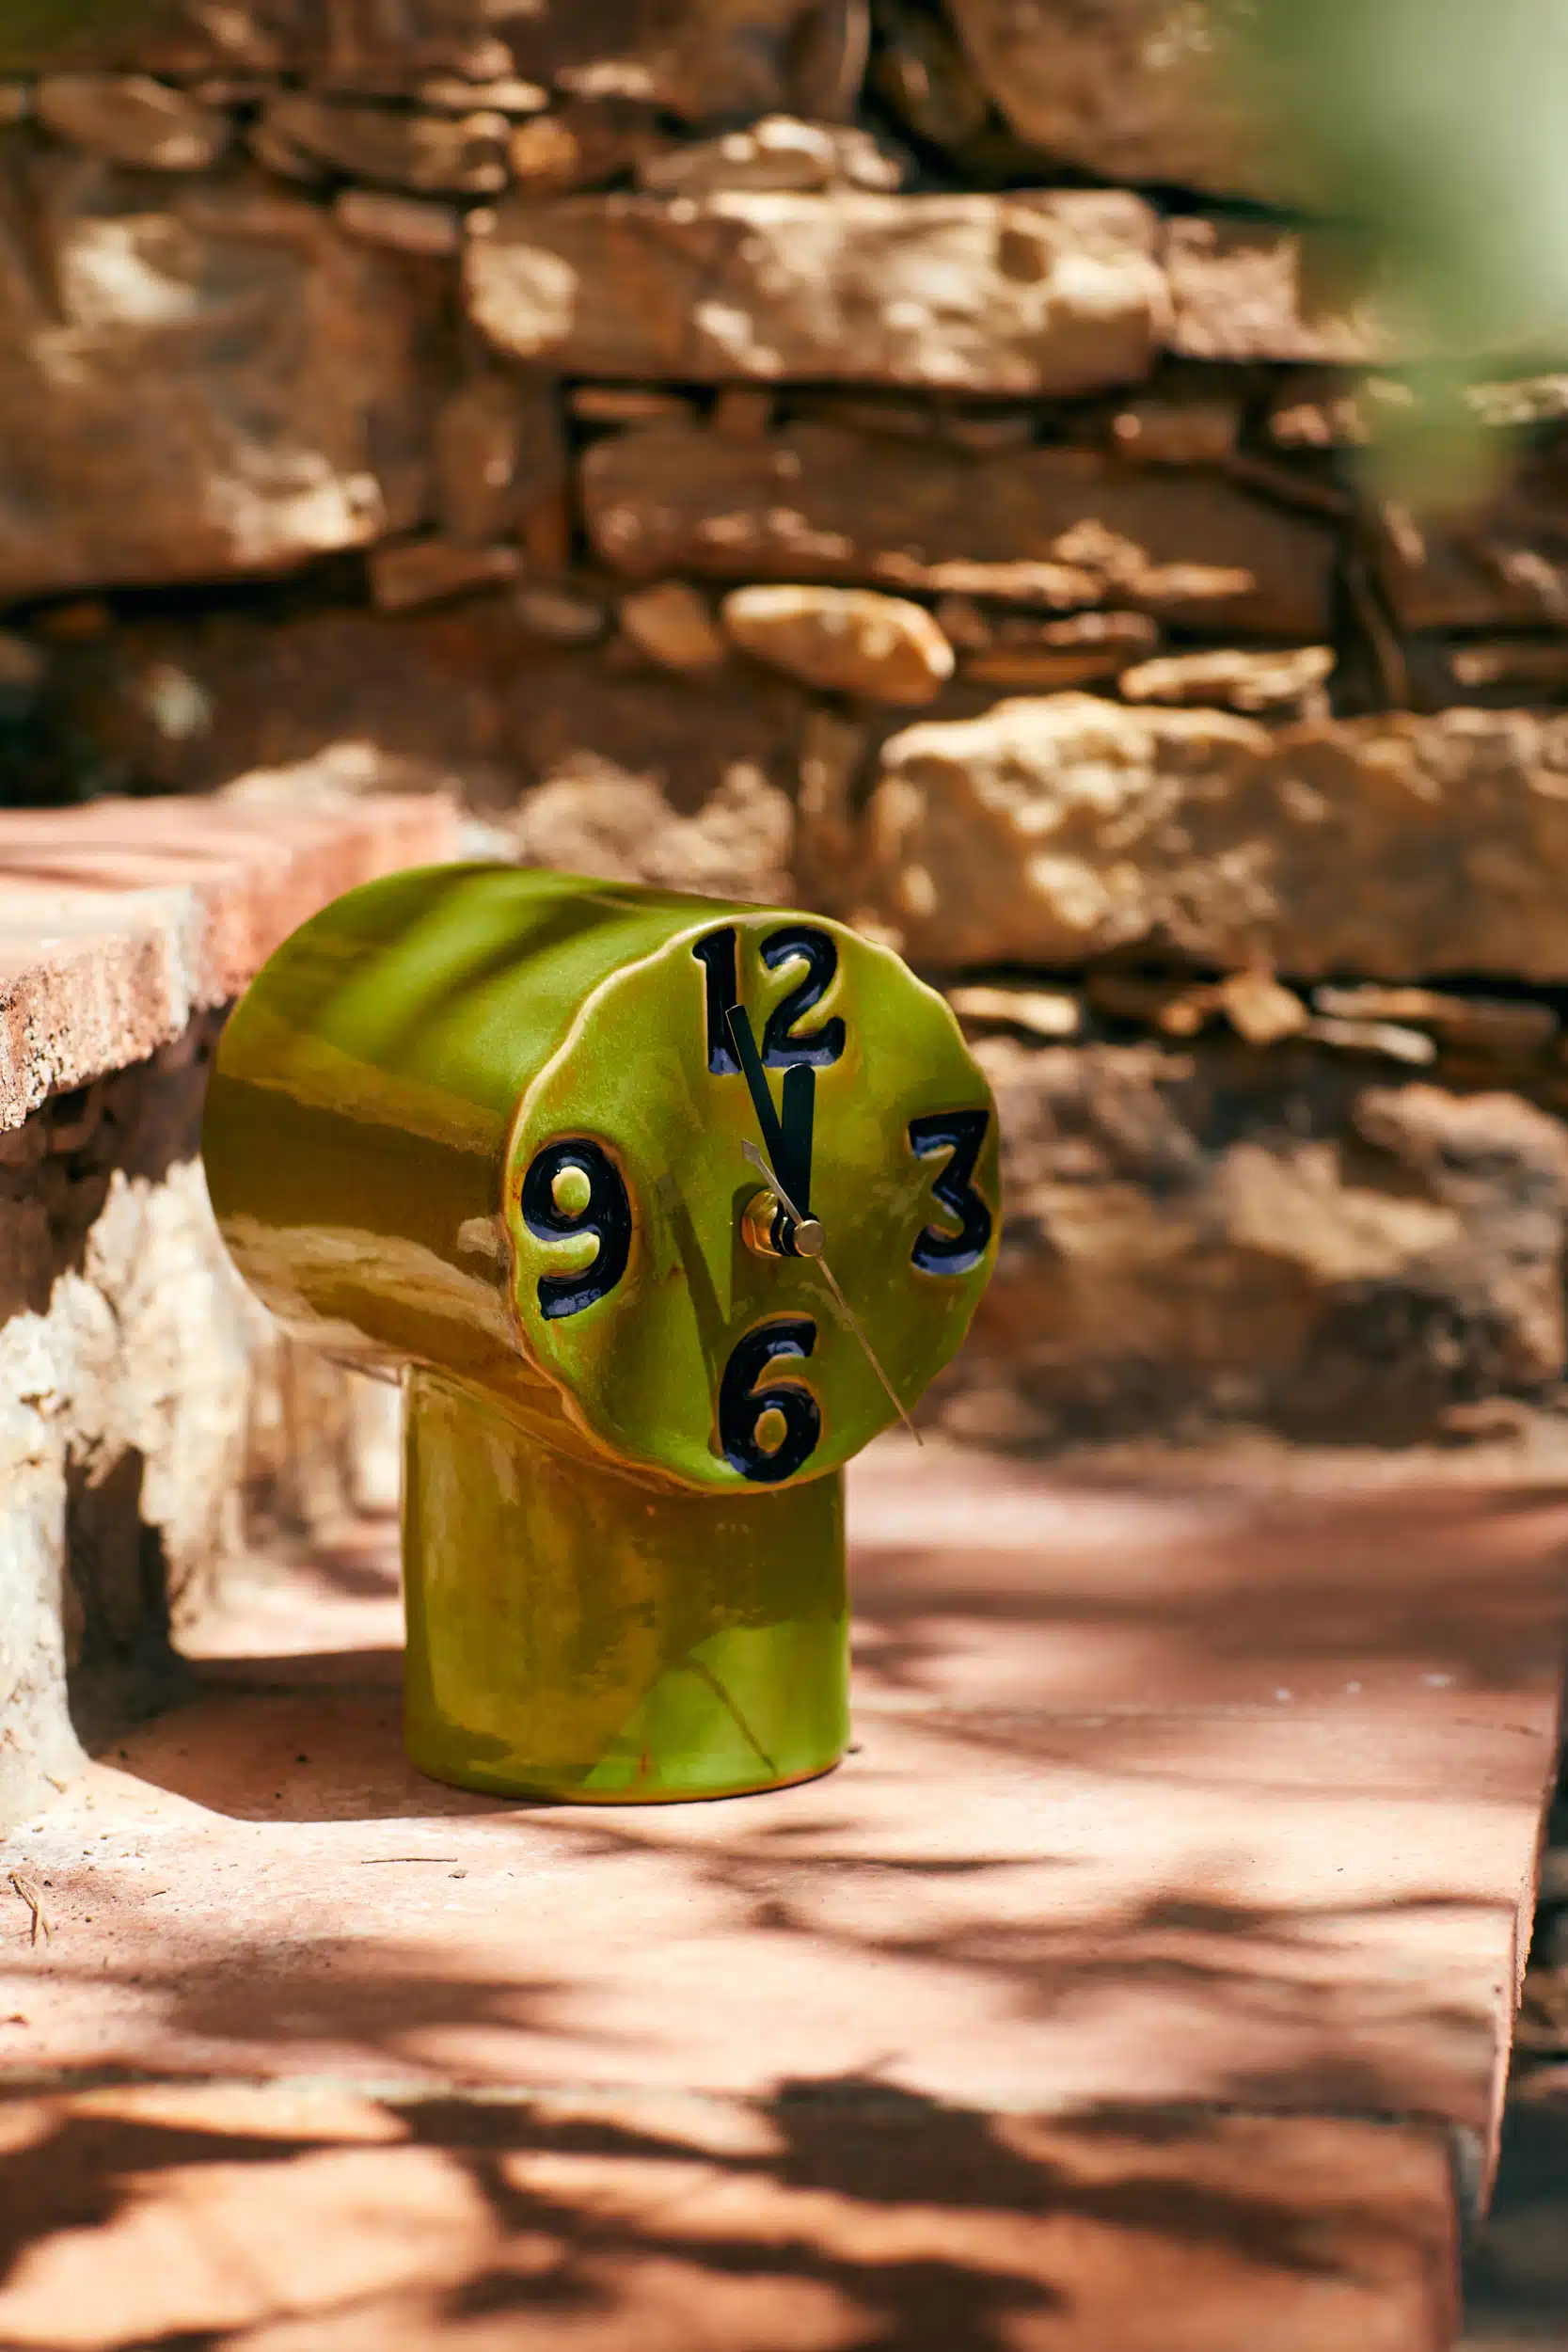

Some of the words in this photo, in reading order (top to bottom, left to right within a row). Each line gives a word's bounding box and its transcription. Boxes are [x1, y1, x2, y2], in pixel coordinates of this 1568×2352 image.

[692, 927, 846, 1075] 12
[521, 1137, 632, 1320] 9
[909, 1110, 991, 1275] 3
[719, 1319, 820, 1483] 6
